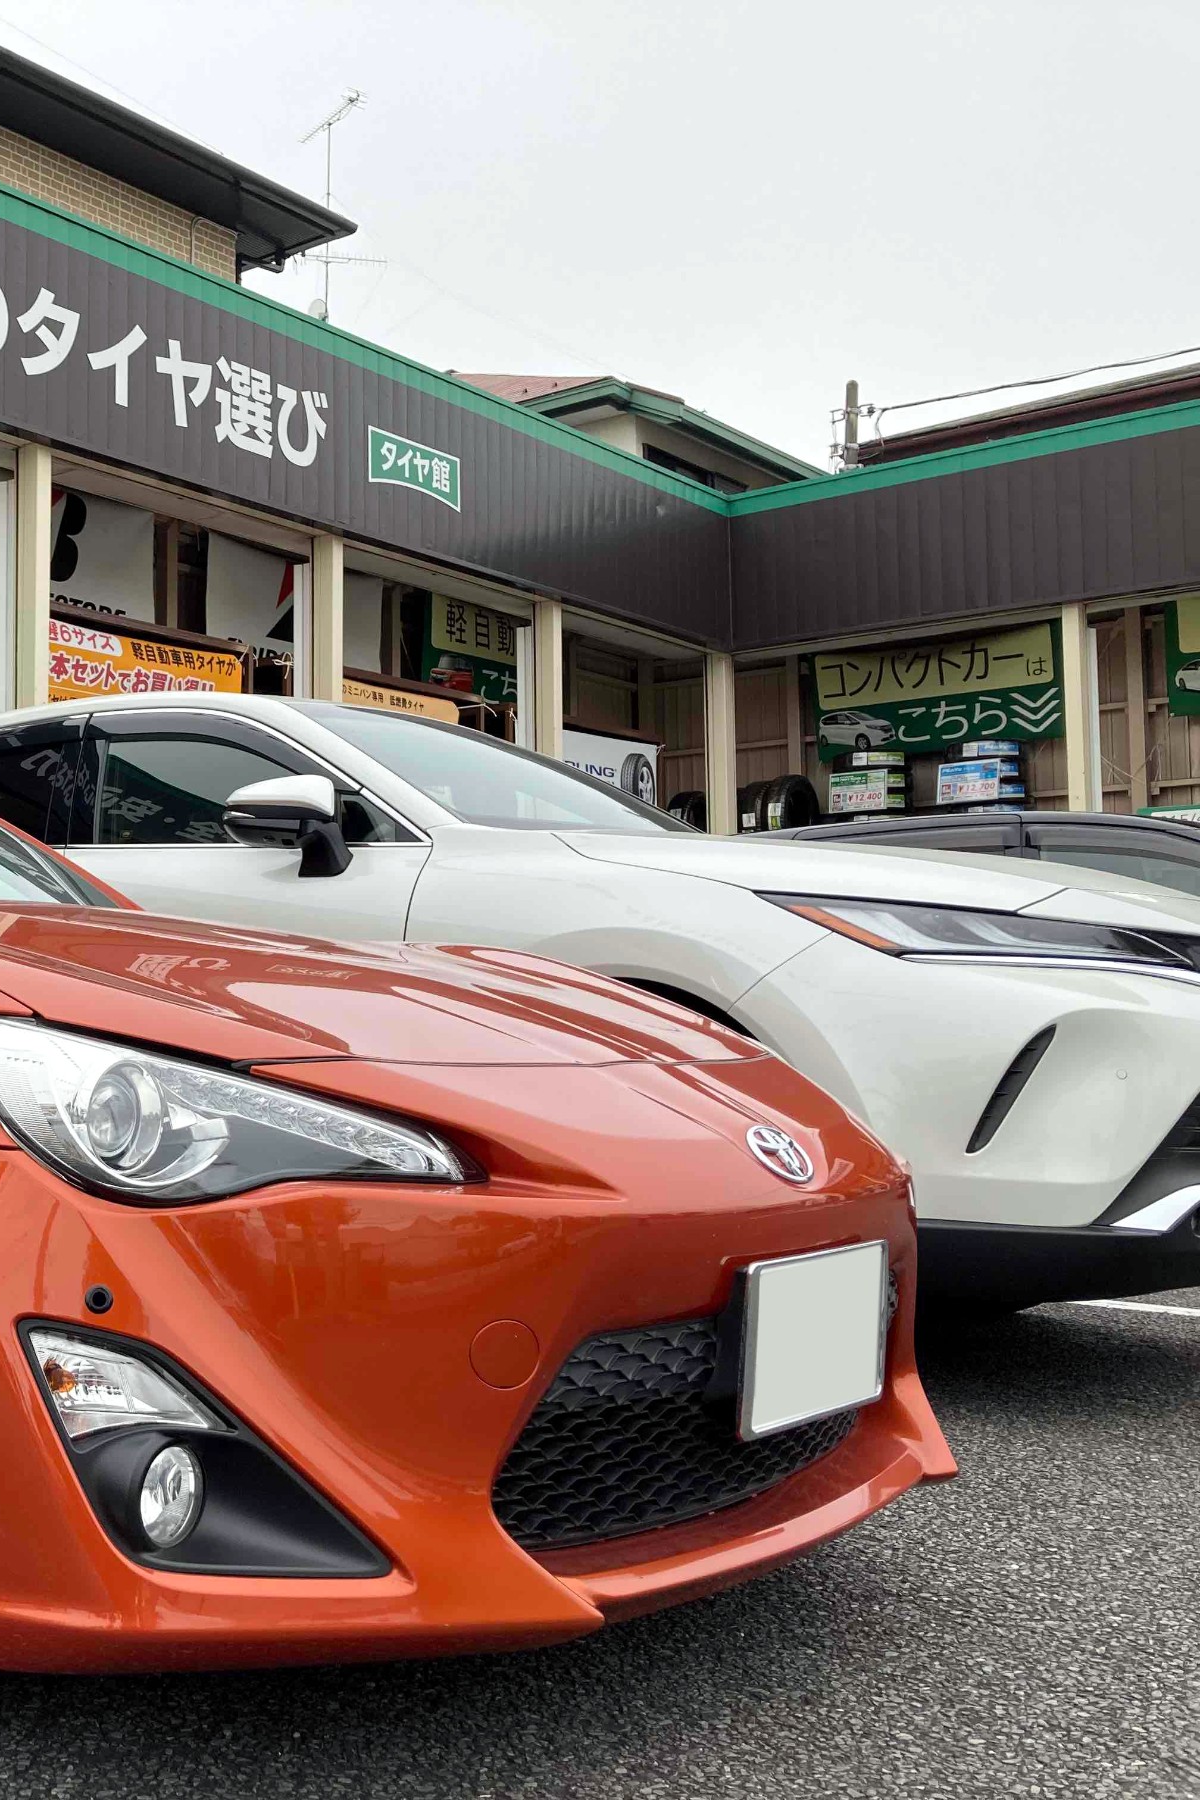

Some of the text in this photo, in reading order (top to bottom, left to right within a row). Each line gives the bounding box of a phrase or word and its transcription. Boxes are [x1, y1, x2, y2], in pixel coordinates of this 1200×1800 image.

[380, 441, 450, 493] タイヤ館
[446, 600, 515, 656] 軽自動
[130, 641, 237, 677] 軽自動車用タイヤが
[821, 642, 1048, 698] コンパクトカーは
[898, 696, 1008, 742] こちら
